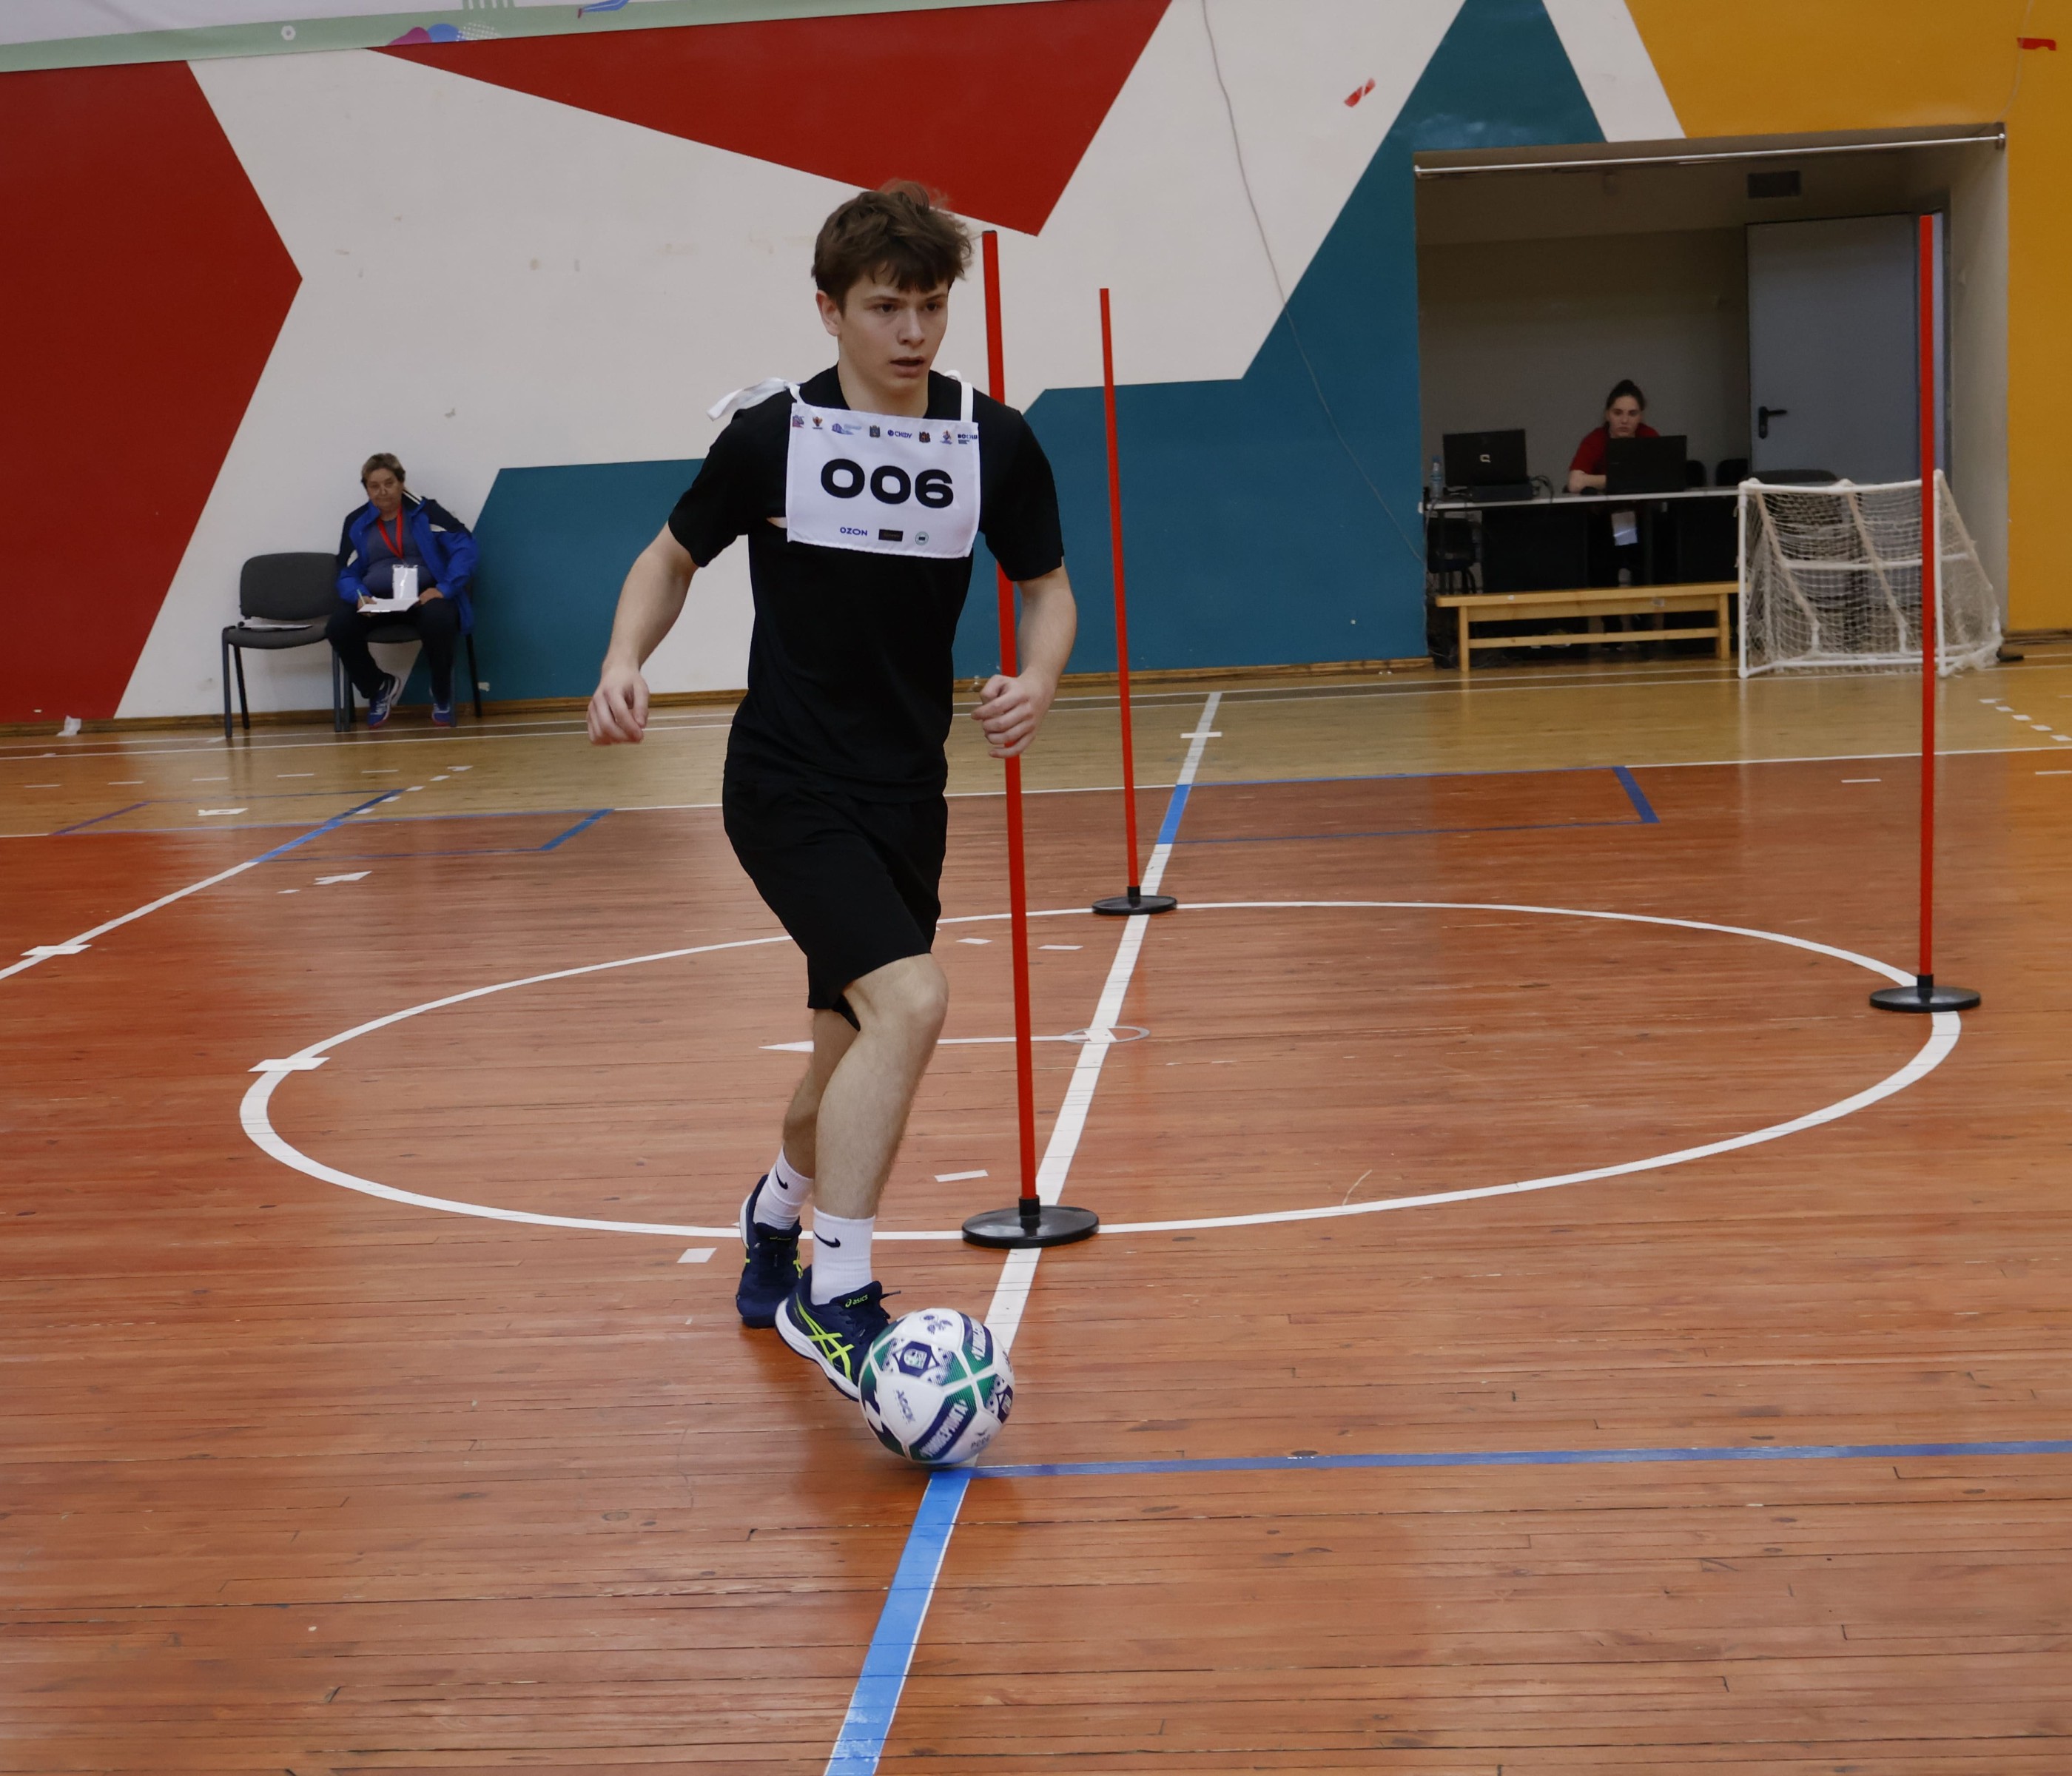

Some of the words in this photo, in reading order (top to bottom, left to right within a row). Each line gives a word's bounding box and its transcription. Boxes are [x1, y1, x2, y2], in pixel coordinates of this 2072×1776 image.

[821, 458, 954, 508] 006
[840, 527, 868, 536] OZON
[852, 1294, 868, 1305] asics
